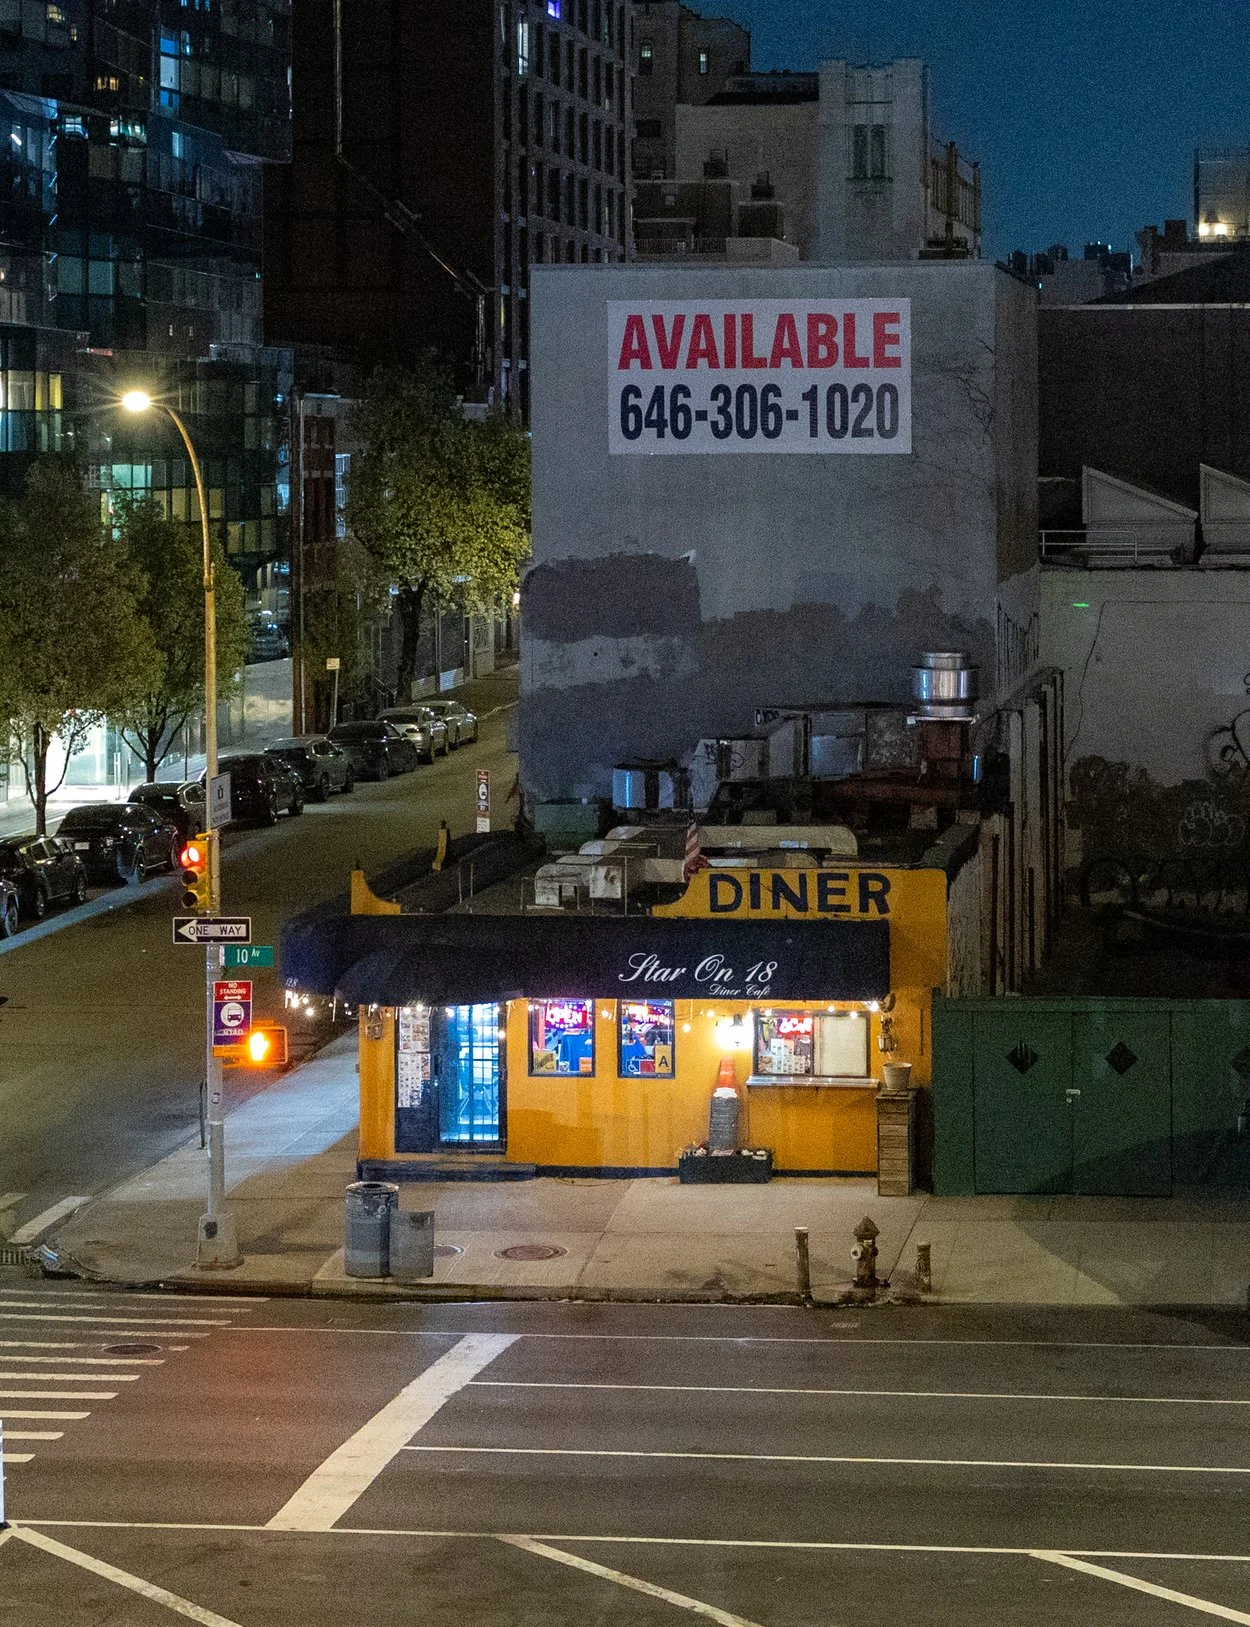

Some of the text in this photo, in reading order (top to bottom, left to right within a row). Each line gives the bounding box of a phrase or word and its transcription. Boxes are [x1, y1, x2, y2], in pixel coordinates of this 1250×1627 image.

[618, 312, 902, 370] AVAILABLE
[620, 383, 900, 440] 646-306-1020
[709, 872, 891, 915] DINER
[188, 926, 242, 936] ONE WAY
[236, 948, 260, 963] 10 Av
[618, 952, 778, 982] Star On 18
[709, 984, 771, 997] Diner Café
[658, 1055, 669, 1068] A
